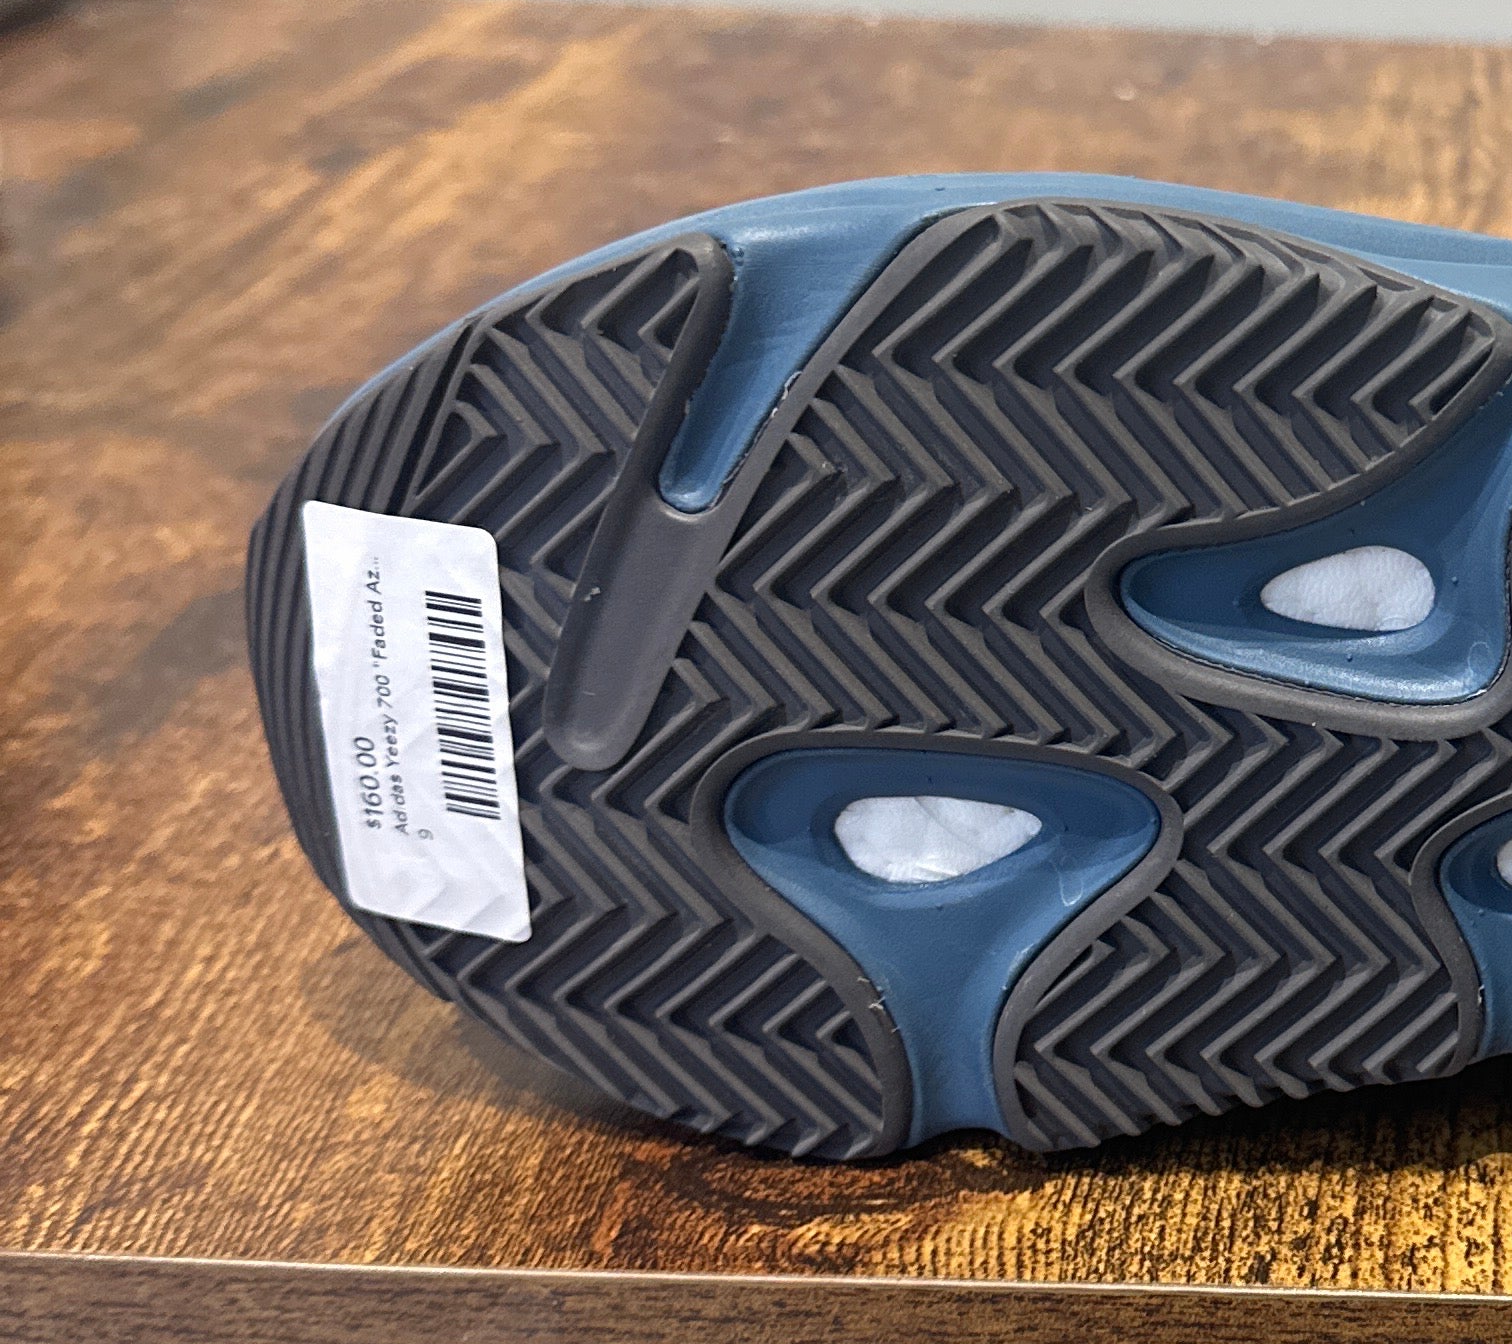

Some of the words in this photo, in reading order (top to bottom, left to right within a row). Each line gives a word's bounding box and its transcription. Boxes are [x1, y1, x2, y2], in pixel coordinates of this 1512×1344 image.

[375, 674, 393, 708] 700
[383, 713, 401, 768] Yeezy
[352, 735, 384, 830] $160.00
